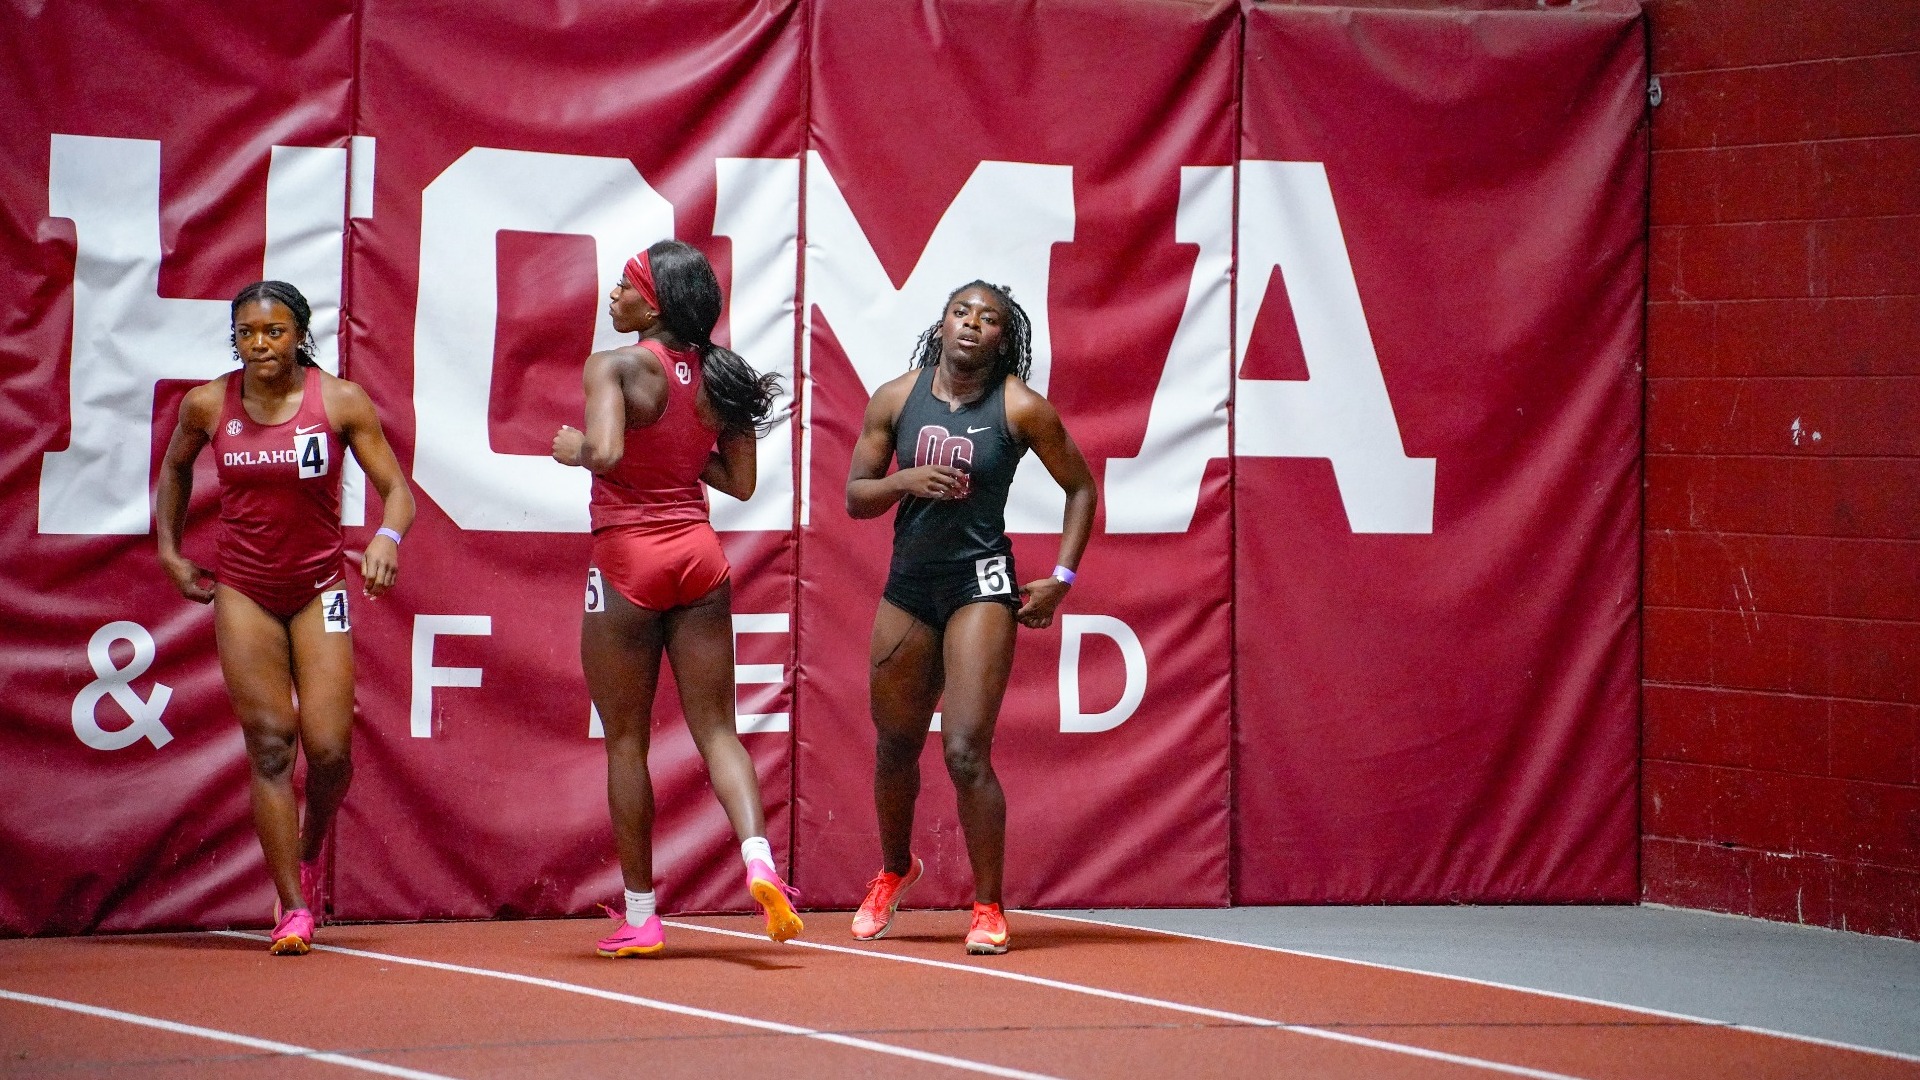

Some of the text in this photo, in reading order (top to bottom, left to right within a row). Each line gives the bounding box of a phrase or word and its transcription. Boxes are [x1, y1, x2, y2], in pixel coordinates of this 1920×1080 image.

[37, 133, 1436, 535] HOMA
[675, 361, 692, 384] OU
[226, 419, 243, 435] SEC
[302, 436, 324, 473] 4
[587, 570, 599, 611] 5
[983, 559, 1004, 592] 6
[327, 593, 347, 629] 4
[72, 613, 1148, 750] & FED
